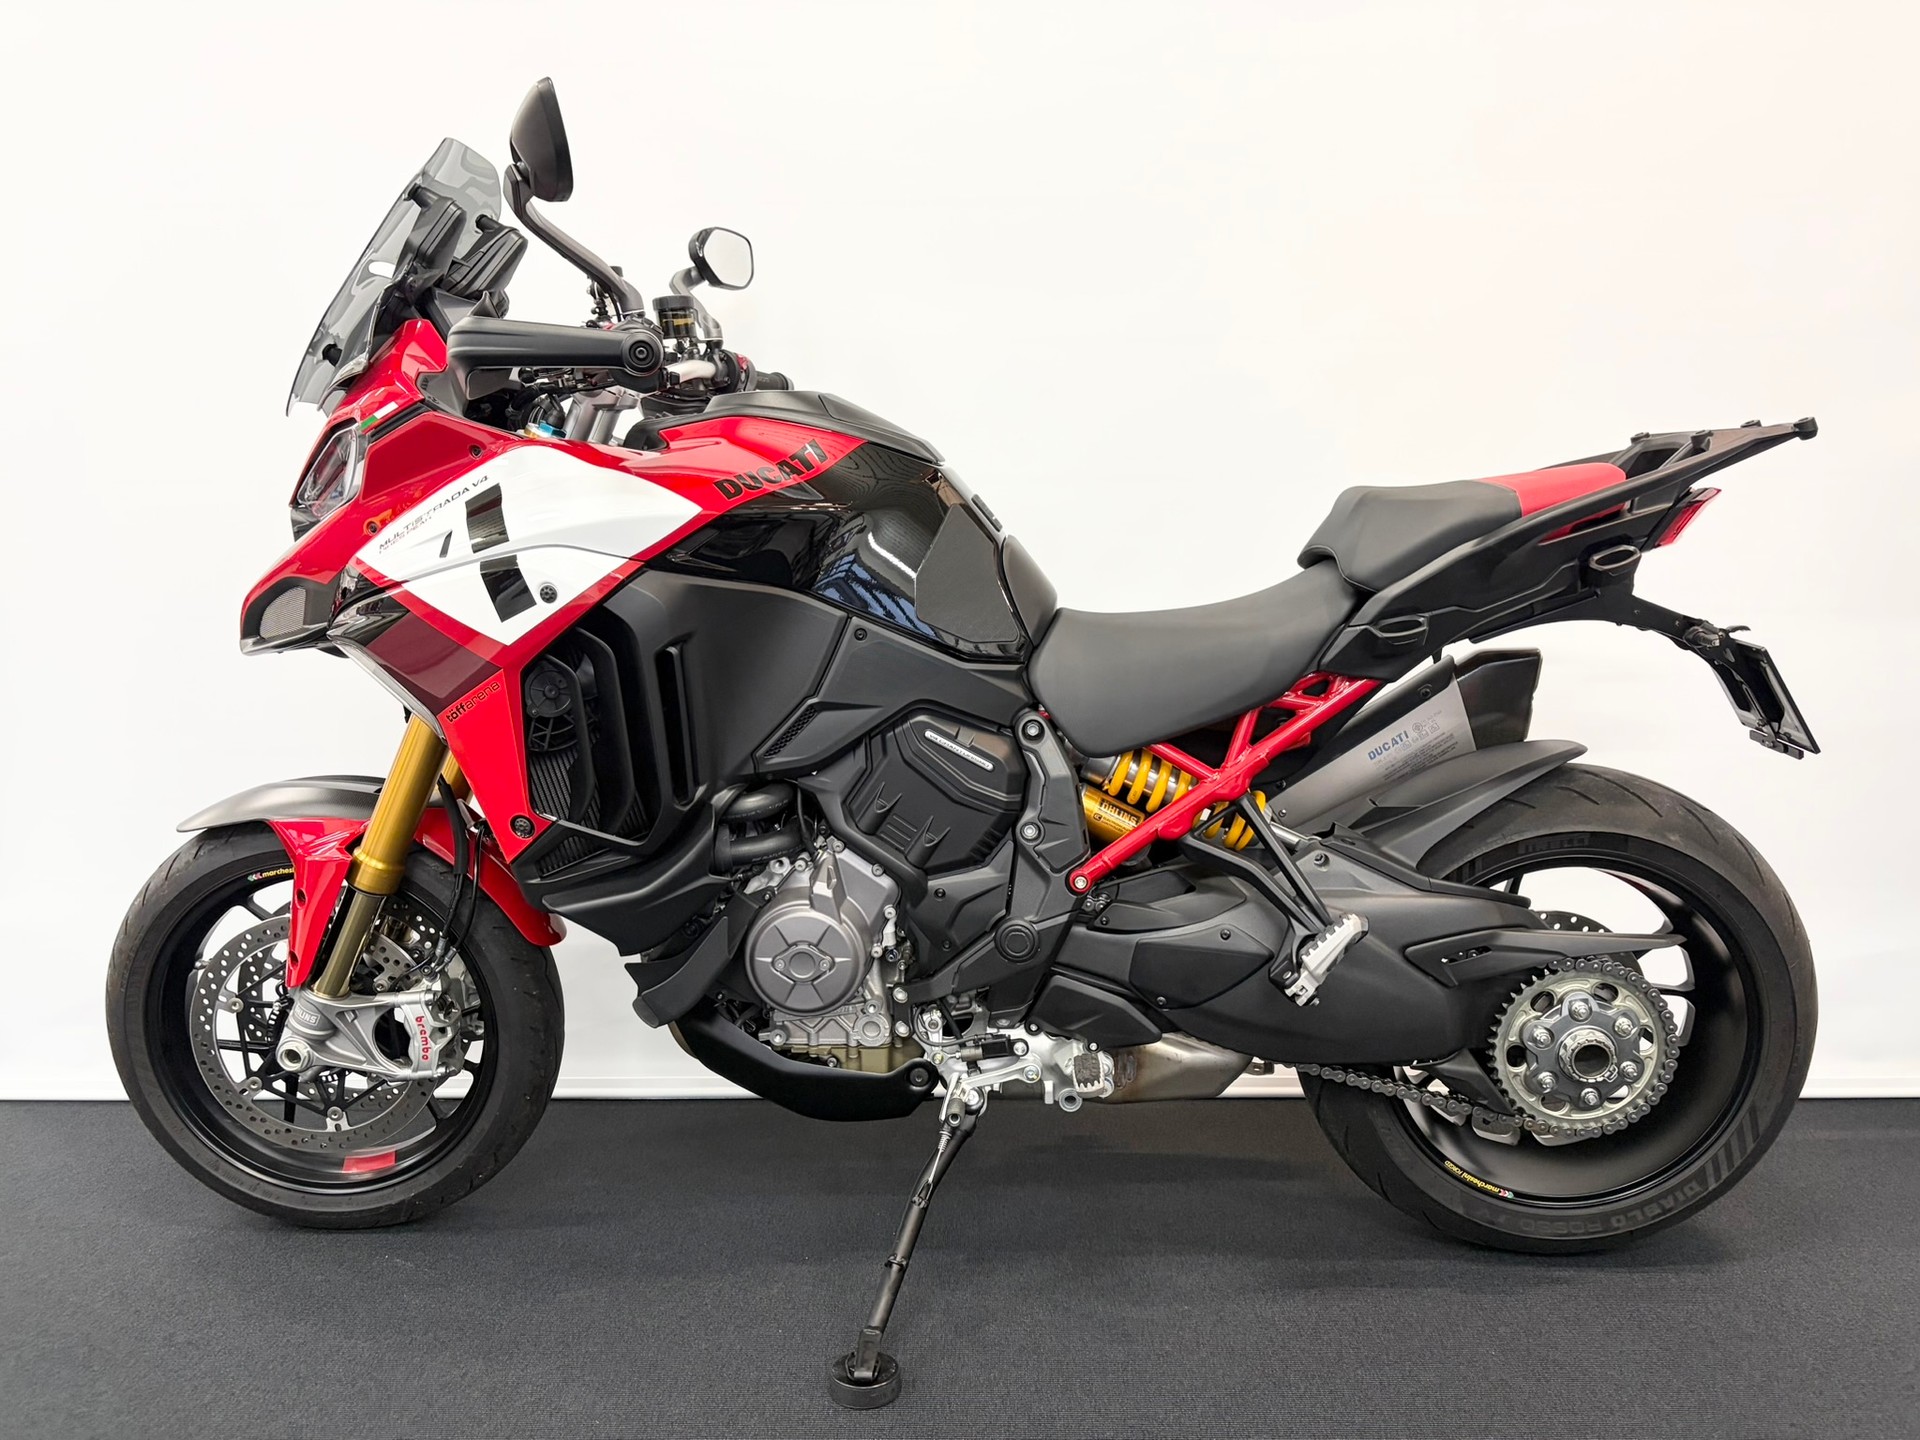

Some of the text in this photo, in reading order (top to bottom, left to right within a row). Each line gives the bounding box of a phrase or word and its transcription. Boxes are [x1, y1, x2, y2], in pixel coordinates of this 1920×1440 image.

[713, 439, 828, 501] DUCATI
[379, 487, 470, 550] MULTISTRADA
[471, 475, 489, 488] V4
[445, 681, 501, 723] töffarena
[1367, 730, 1410, 761] DUCATI
[414, 1015, 432, 1061] brembo
[1461, 1171, 1500, 1193] marchesini
[1522, 1178, 1704, 1234] DIABLO ROSSO
